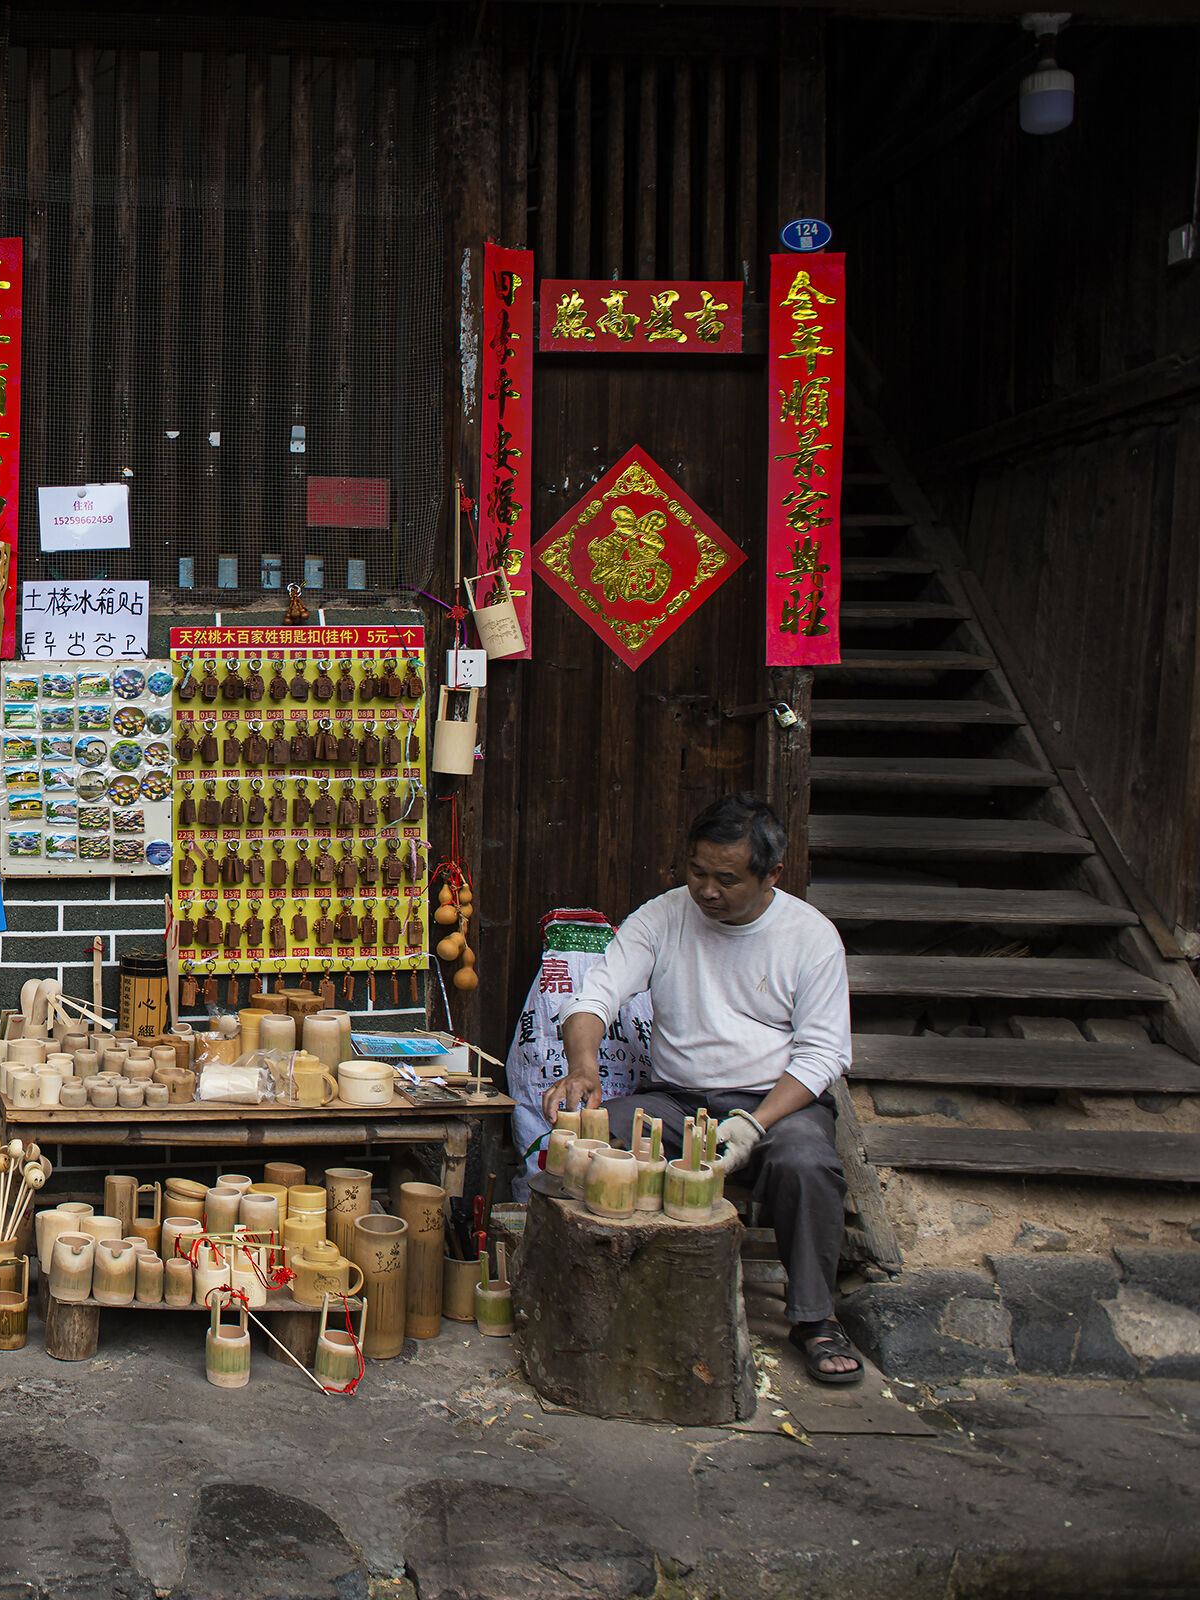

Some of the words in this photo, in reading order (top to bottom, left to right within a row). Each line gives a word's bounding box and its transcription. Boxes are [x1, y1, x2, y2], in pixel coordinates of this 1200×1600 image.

[796, 223, 818, 236] 124
[53, 515, 113, 525] 15259662459
[72, 500, 94, 511] 住宿
[588, 505, 673, 605] 福
[23, 585, 144, 617] 土楼冰箱贴
[539, 958, 573, 994] 嘉
[138, 998, 157, 1037] 心經
